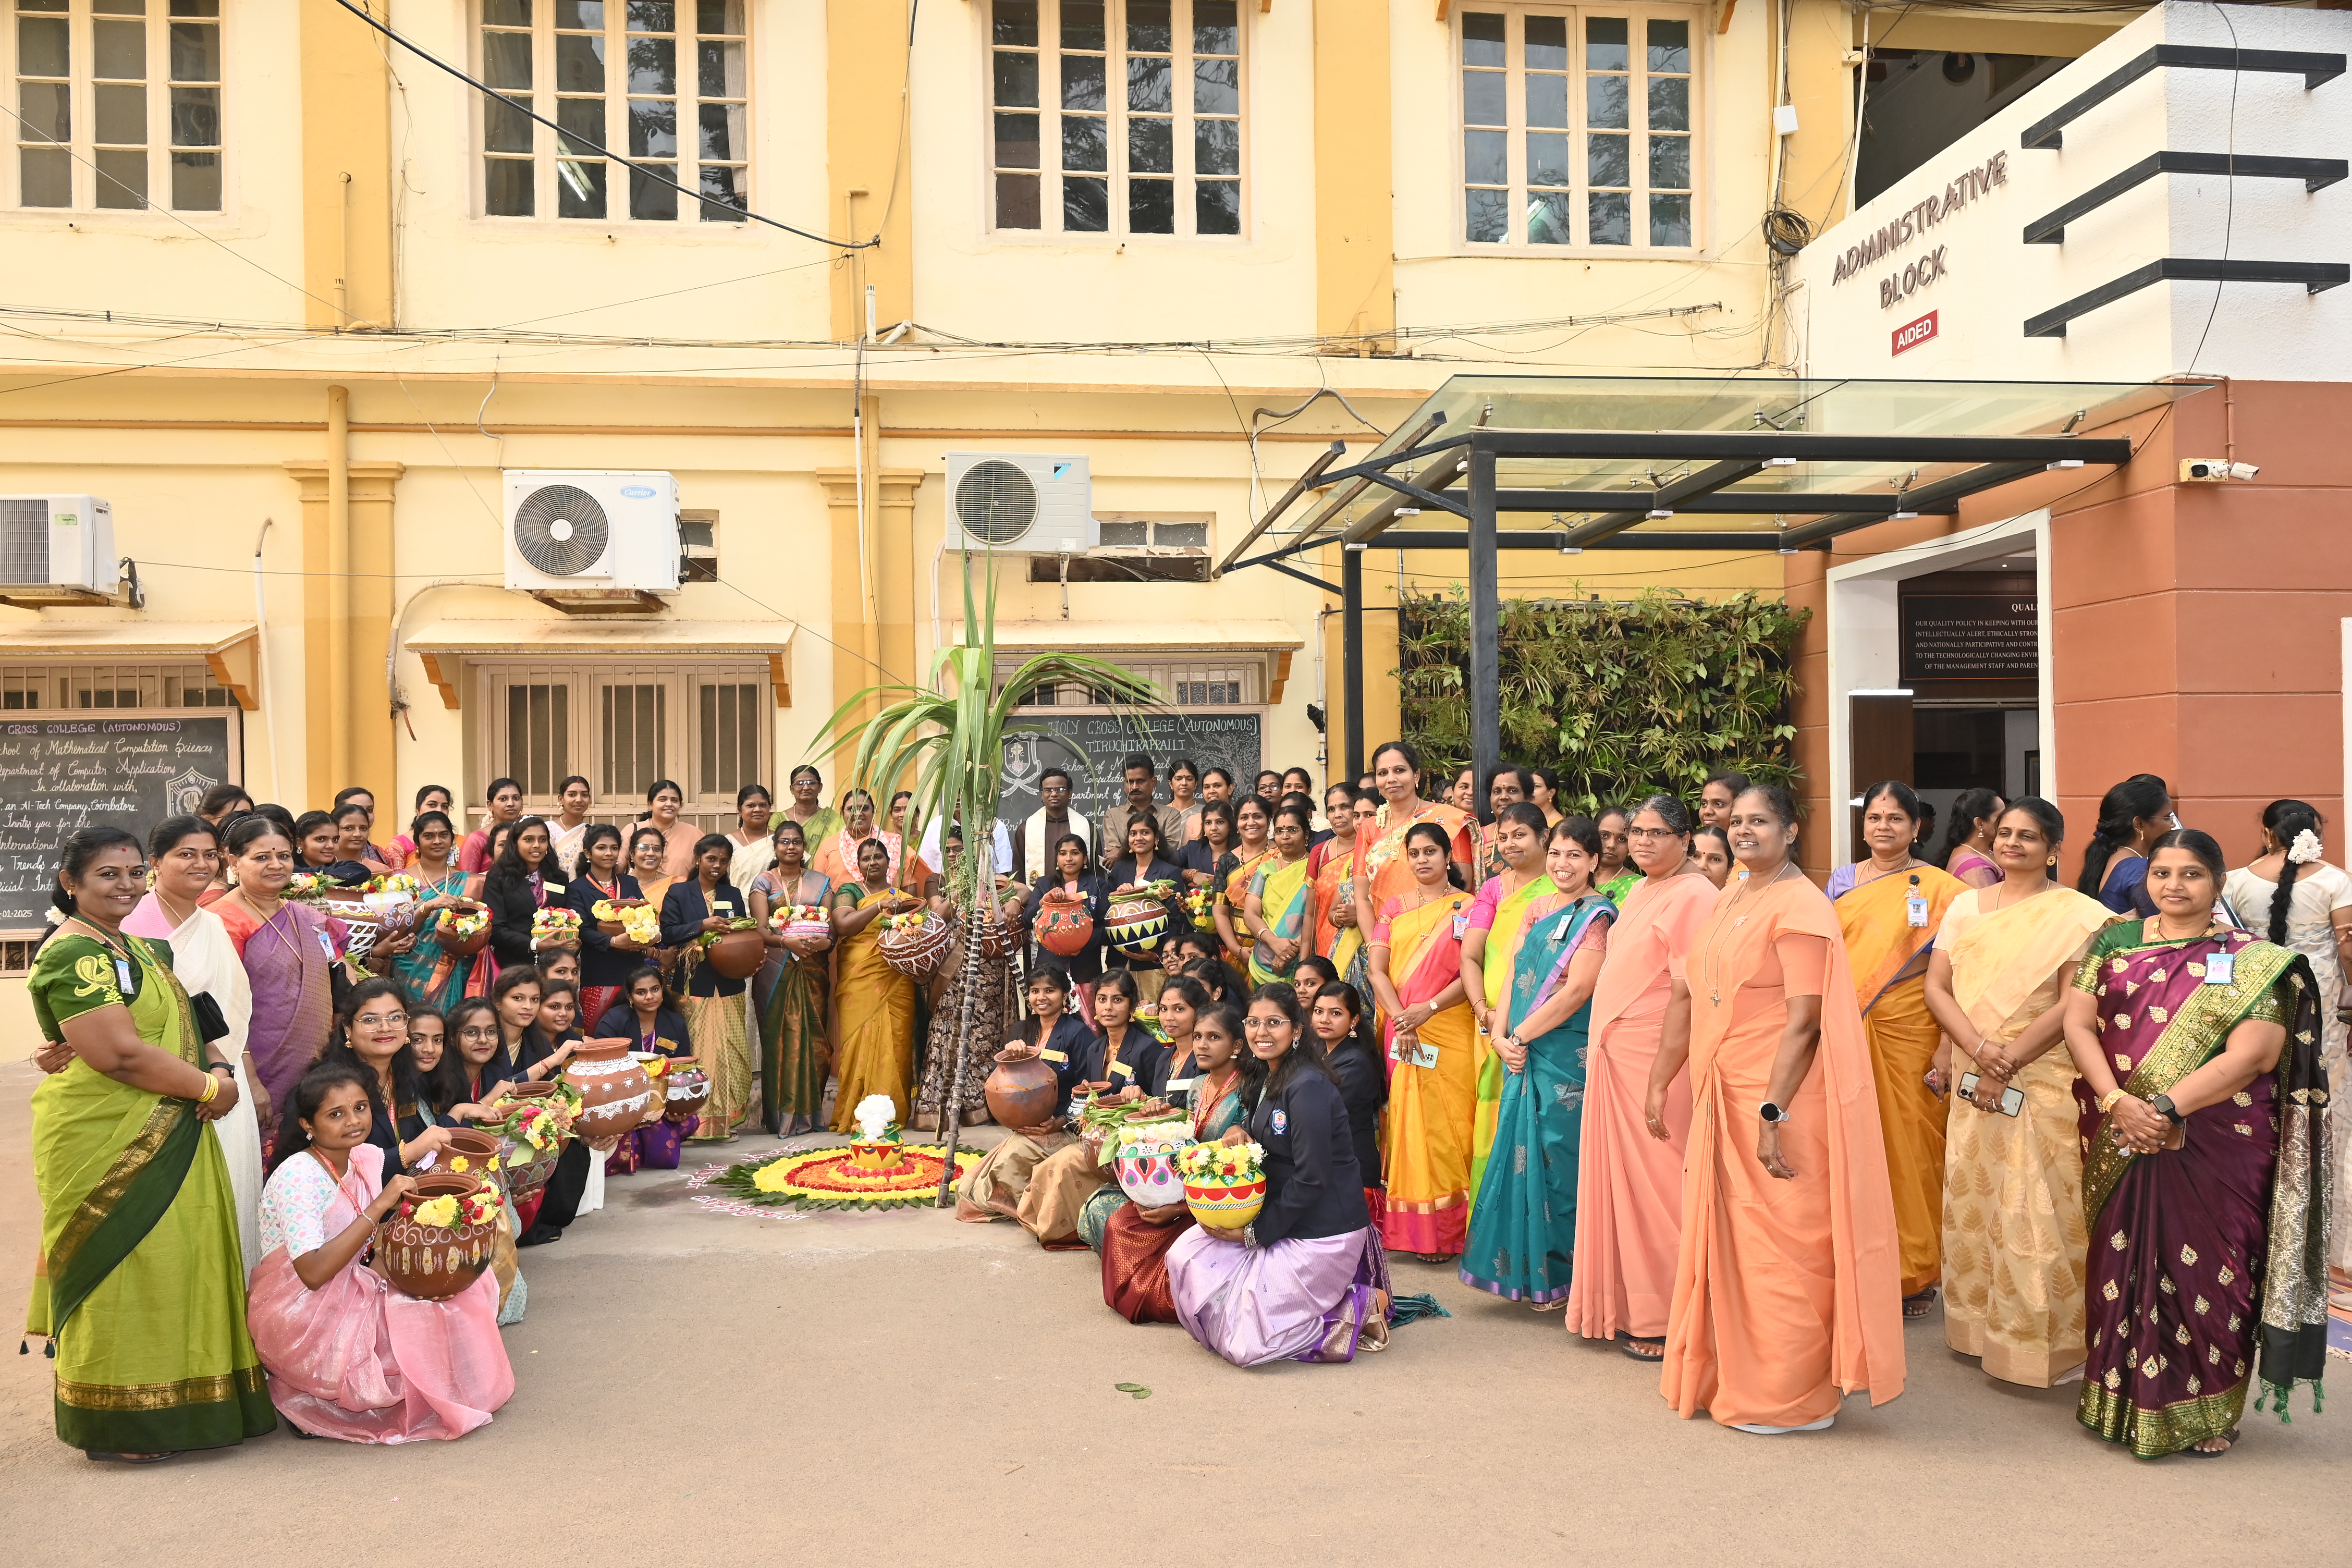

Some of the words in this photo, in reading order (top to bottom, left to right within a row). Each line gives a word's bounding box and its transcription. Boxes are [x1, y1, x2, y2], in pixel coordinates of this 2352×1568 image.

[1832, 150, 2007, 286] ADMINISTRATIVE
[1880, 243, 1946, 309] BLOCK
[1897, 319, 1932, 349] AIDED
[8, 724, 38, 734] CROSS
[47, 724, 95, 733] COLLEGE
[103, 720, 181, 734] (AUTONOMOUS)
[1047, 719, 1080, 737] HOLY
[1087, 720, 1121, 734] CROSS
[1126, 719, 1174, 734] COLLEGE
[1178, 716, 1257, 736] (AUTONOMOUS)
[0, 742, 21, 755] hool
[30, 743, 41, 761] of
[45, 740, 109, 755] Mathematical
[114, 737, 168, 757] Computation
[175, 737, 213, 757] Sciences
[48, 763, 61, 781] of
[68, 760, 107, 779] Computer
[116, 756, 176, 778] Applications
[1061, 757, 1091, 772] School
[1095, 760, 1106, 773] of
[31, 778, 46, 792] In
[50, 778, 108, 792] collaboration
[113, 779, 138, 793] with,
[1082, 771, 1124, 786] Computatio
[20, 799, 51, 810] AI-Tech
[91, 797, 138, 811] Coimbatore.
[1113, 789, 1122, 806] of
[3, 812, 31, 830] Invites
[34, 820, 51, 834] you
[57, 818, 71, 833] for
[10, 854, 45, 873] Trends
